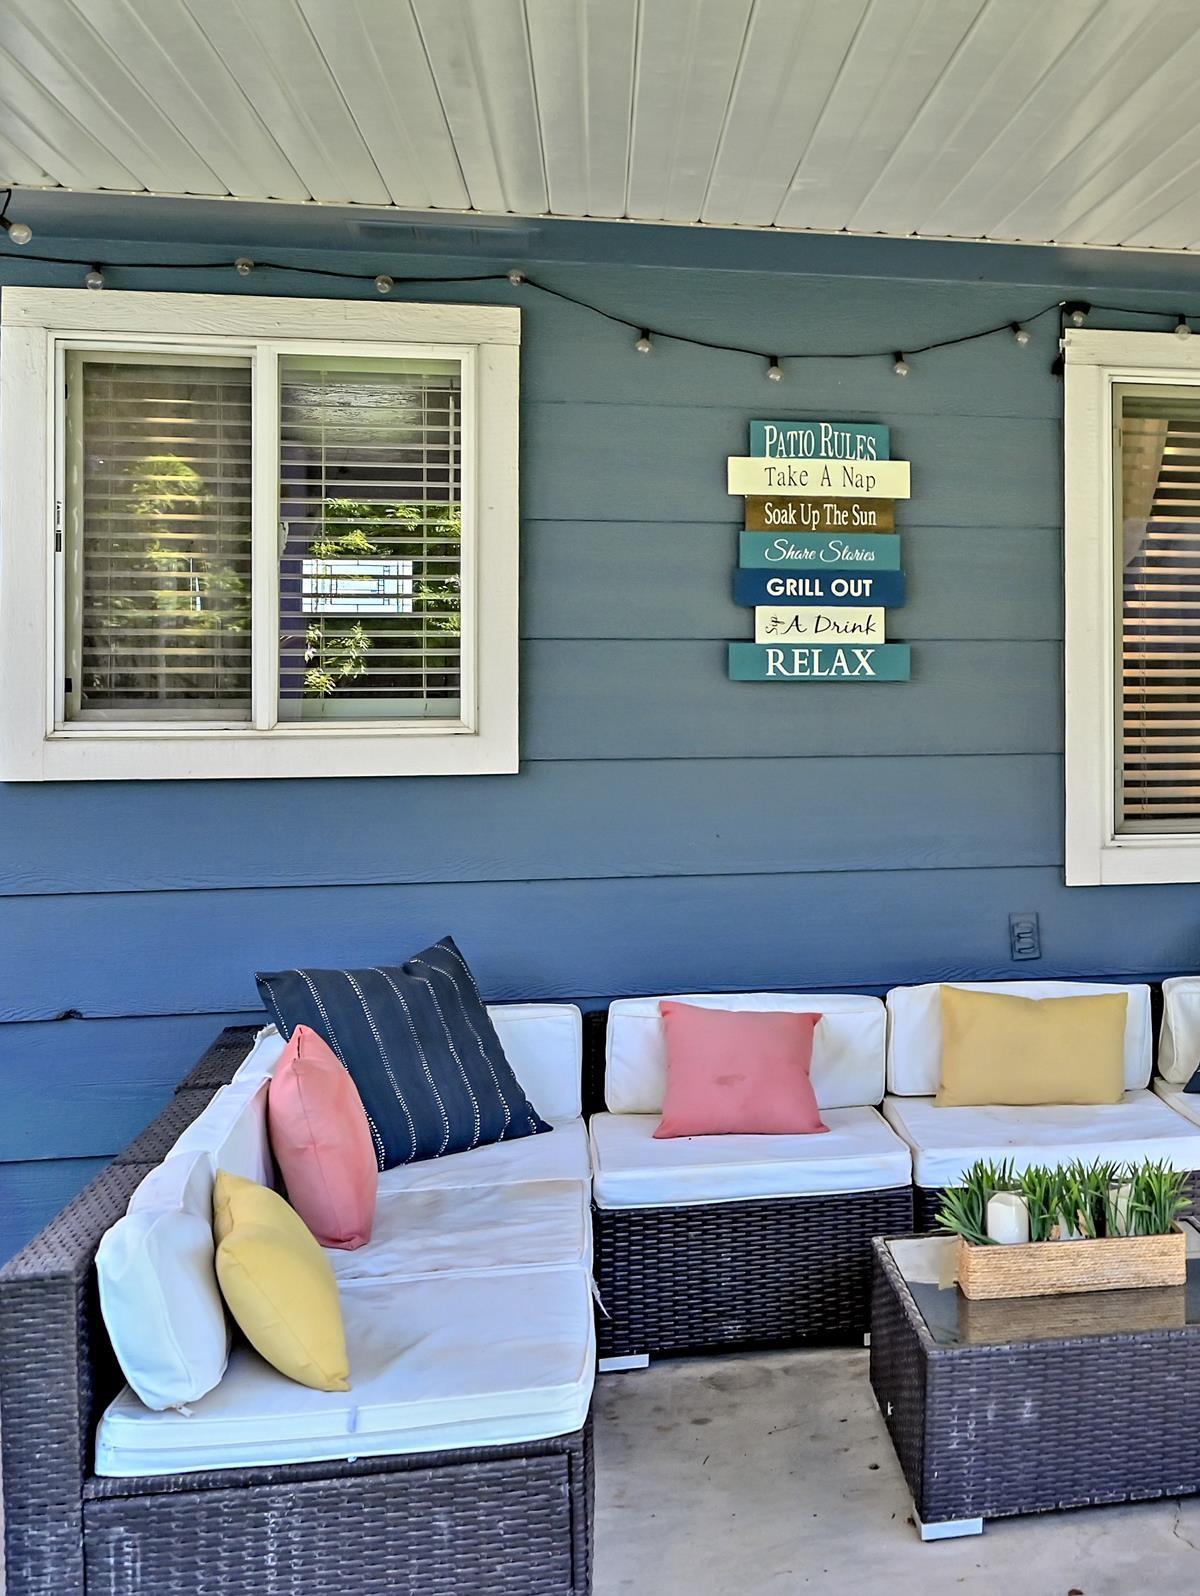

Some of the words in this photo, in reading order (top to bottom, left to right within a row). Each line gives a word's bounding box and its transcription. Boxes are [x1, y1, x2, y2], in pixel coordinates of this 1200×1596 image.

[764, 424, 815, 459] PATIO
[819, 422, 876, 461] RULES
[764, 465, 809, 487] Take
[820, 465, 832, 487] A
[842, 466, 876, 492] Nap
[764, 502, 797, 526] Soak
[801, 504, 820, 531] Up
[823, 504, 849, 526] The
[852, 504, 877, 526] Sun
[764, 538, 817, 562] Share
[819, 540, 876, 563] Stories
[766, 577, 824, 597] GRILL
[830, 579, 873, 597] OUT
[781, 614, 808, 635] A
[814, 614, 877, 636] Drink
[765, 648, 876, 677] RELAX
